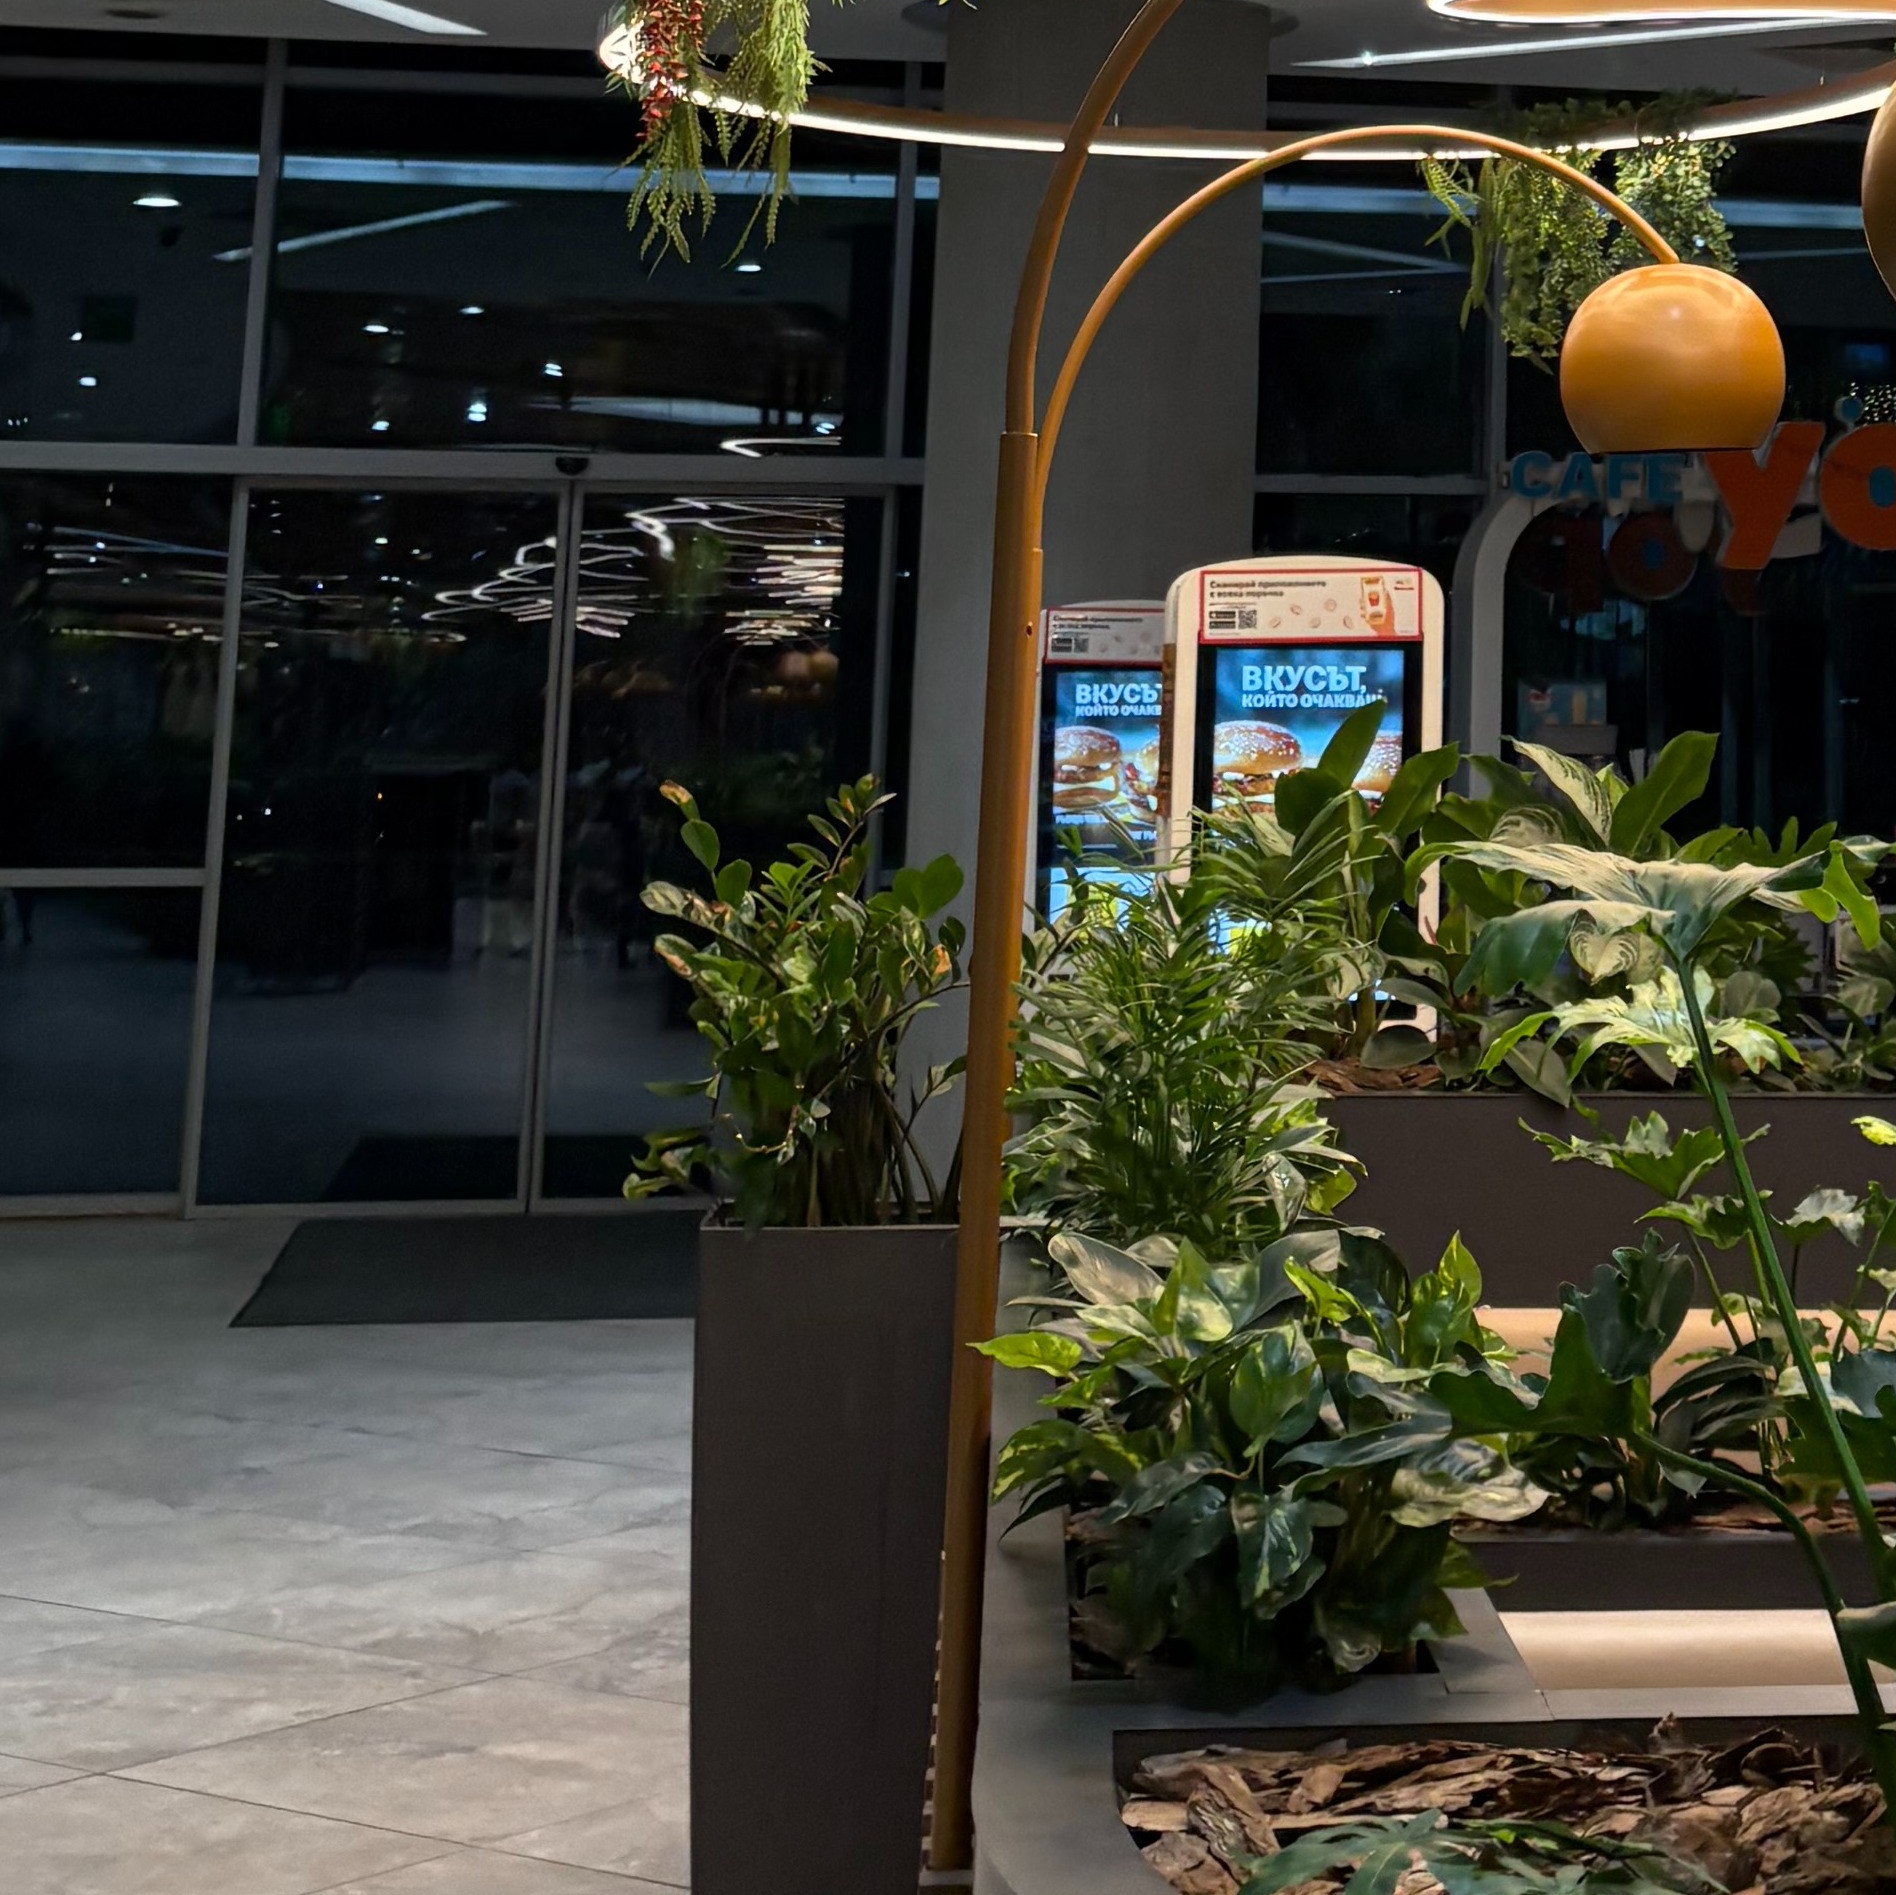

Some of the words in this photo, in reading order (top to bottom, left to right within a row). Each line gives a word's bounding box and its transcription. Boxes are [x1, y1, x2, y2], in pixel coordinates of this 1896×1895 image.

[1241, 664, 1367, 694] ВКУСЪТ,
[1075, 682, 1163, 704] ВКУСЪ
[1241, 690, 1299, 708] КОЙТО
[1075, 703, 1119, 717] КОЙТО
